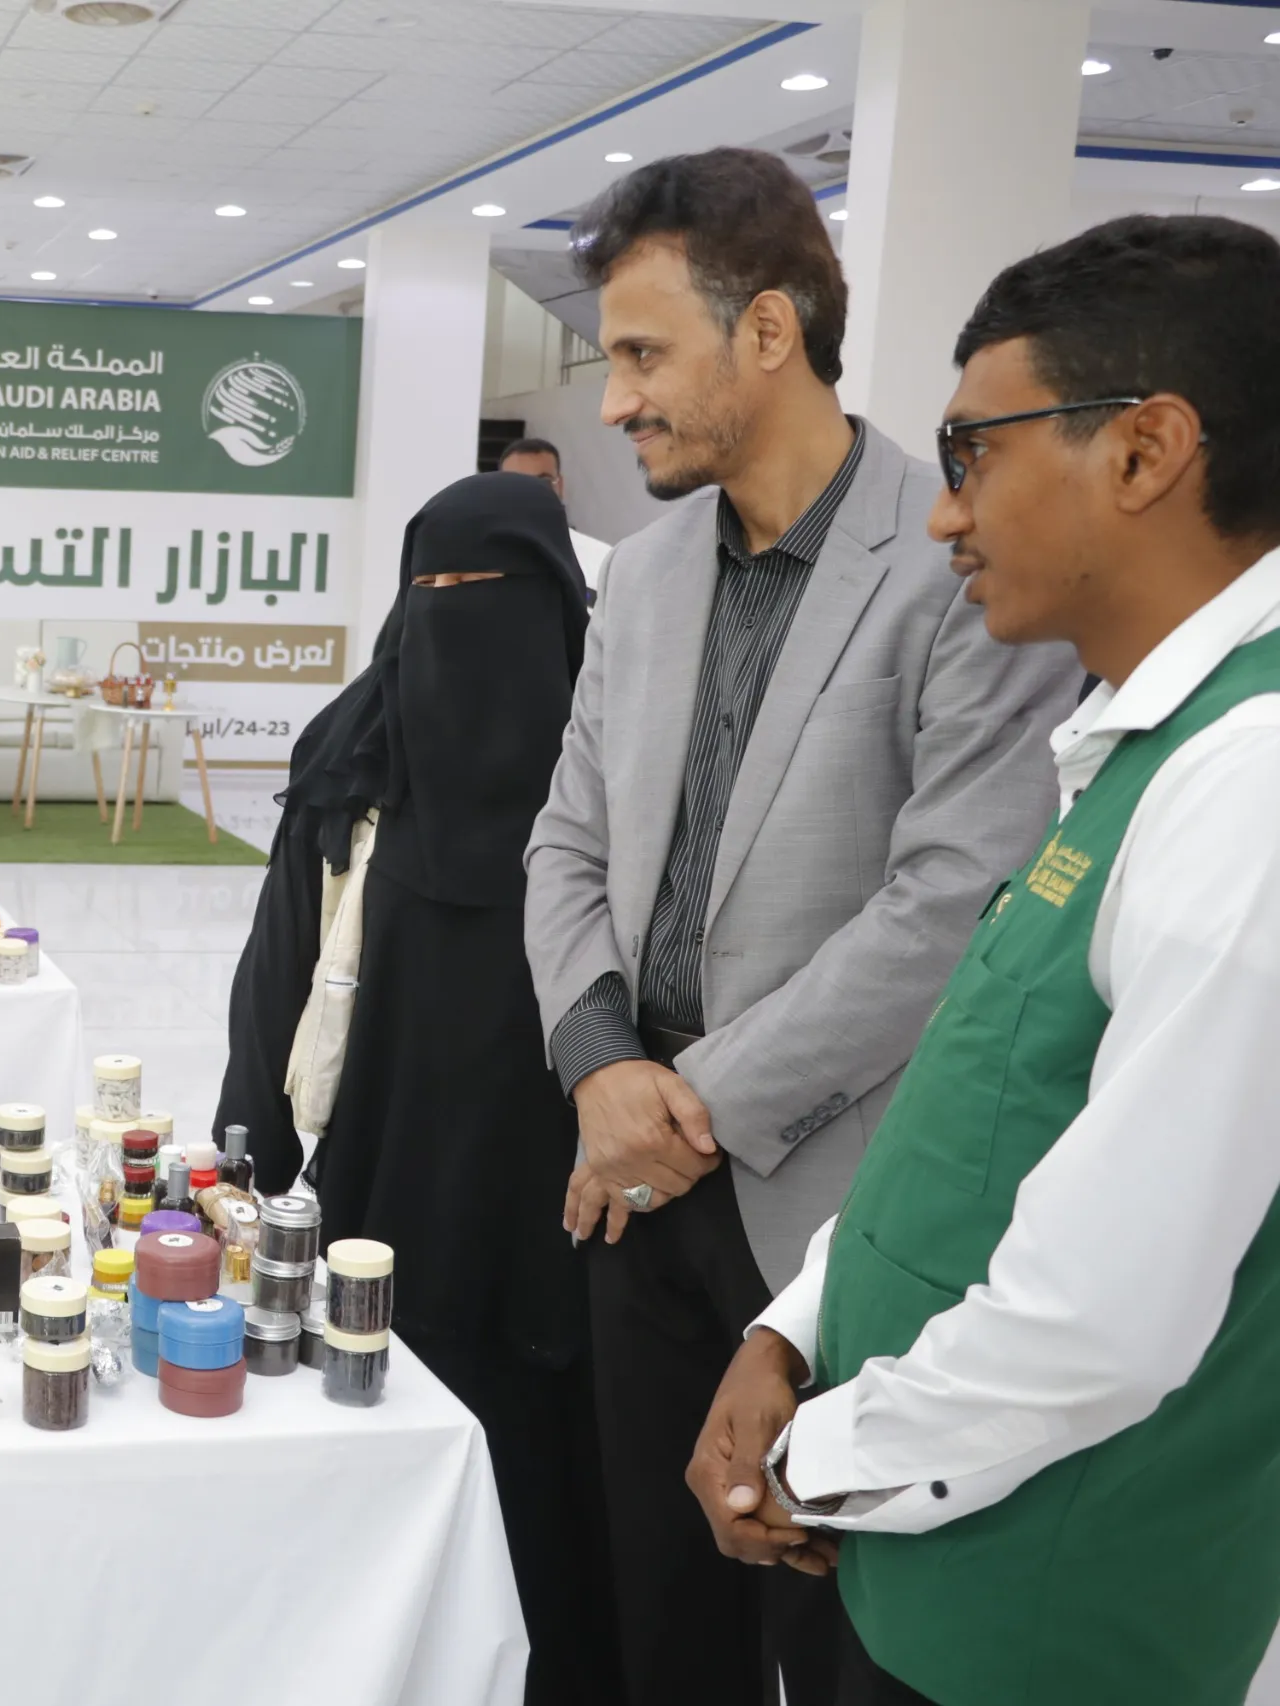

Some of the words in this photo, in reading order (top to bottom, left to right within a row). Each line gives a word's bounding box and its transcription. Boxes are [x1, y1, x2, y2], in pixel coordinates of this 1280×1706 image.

[47, 343, 164, 377] المملكة
[59, 387, 162, 413] ARABIA
[64, 423, 116, 440] الملك
[116, 425, 161, 444] مركز
[9, 445, 37, 460] AID
[37, 447, 50, 461] &
[51, 447, 100, 462] RELIEF
[101, 448, 160, 464] CENTRE
[156, 531, 330, 607] البازار
[140, 634, 246, 670] منتجات
[253, 637, 336, 672] لعرض
